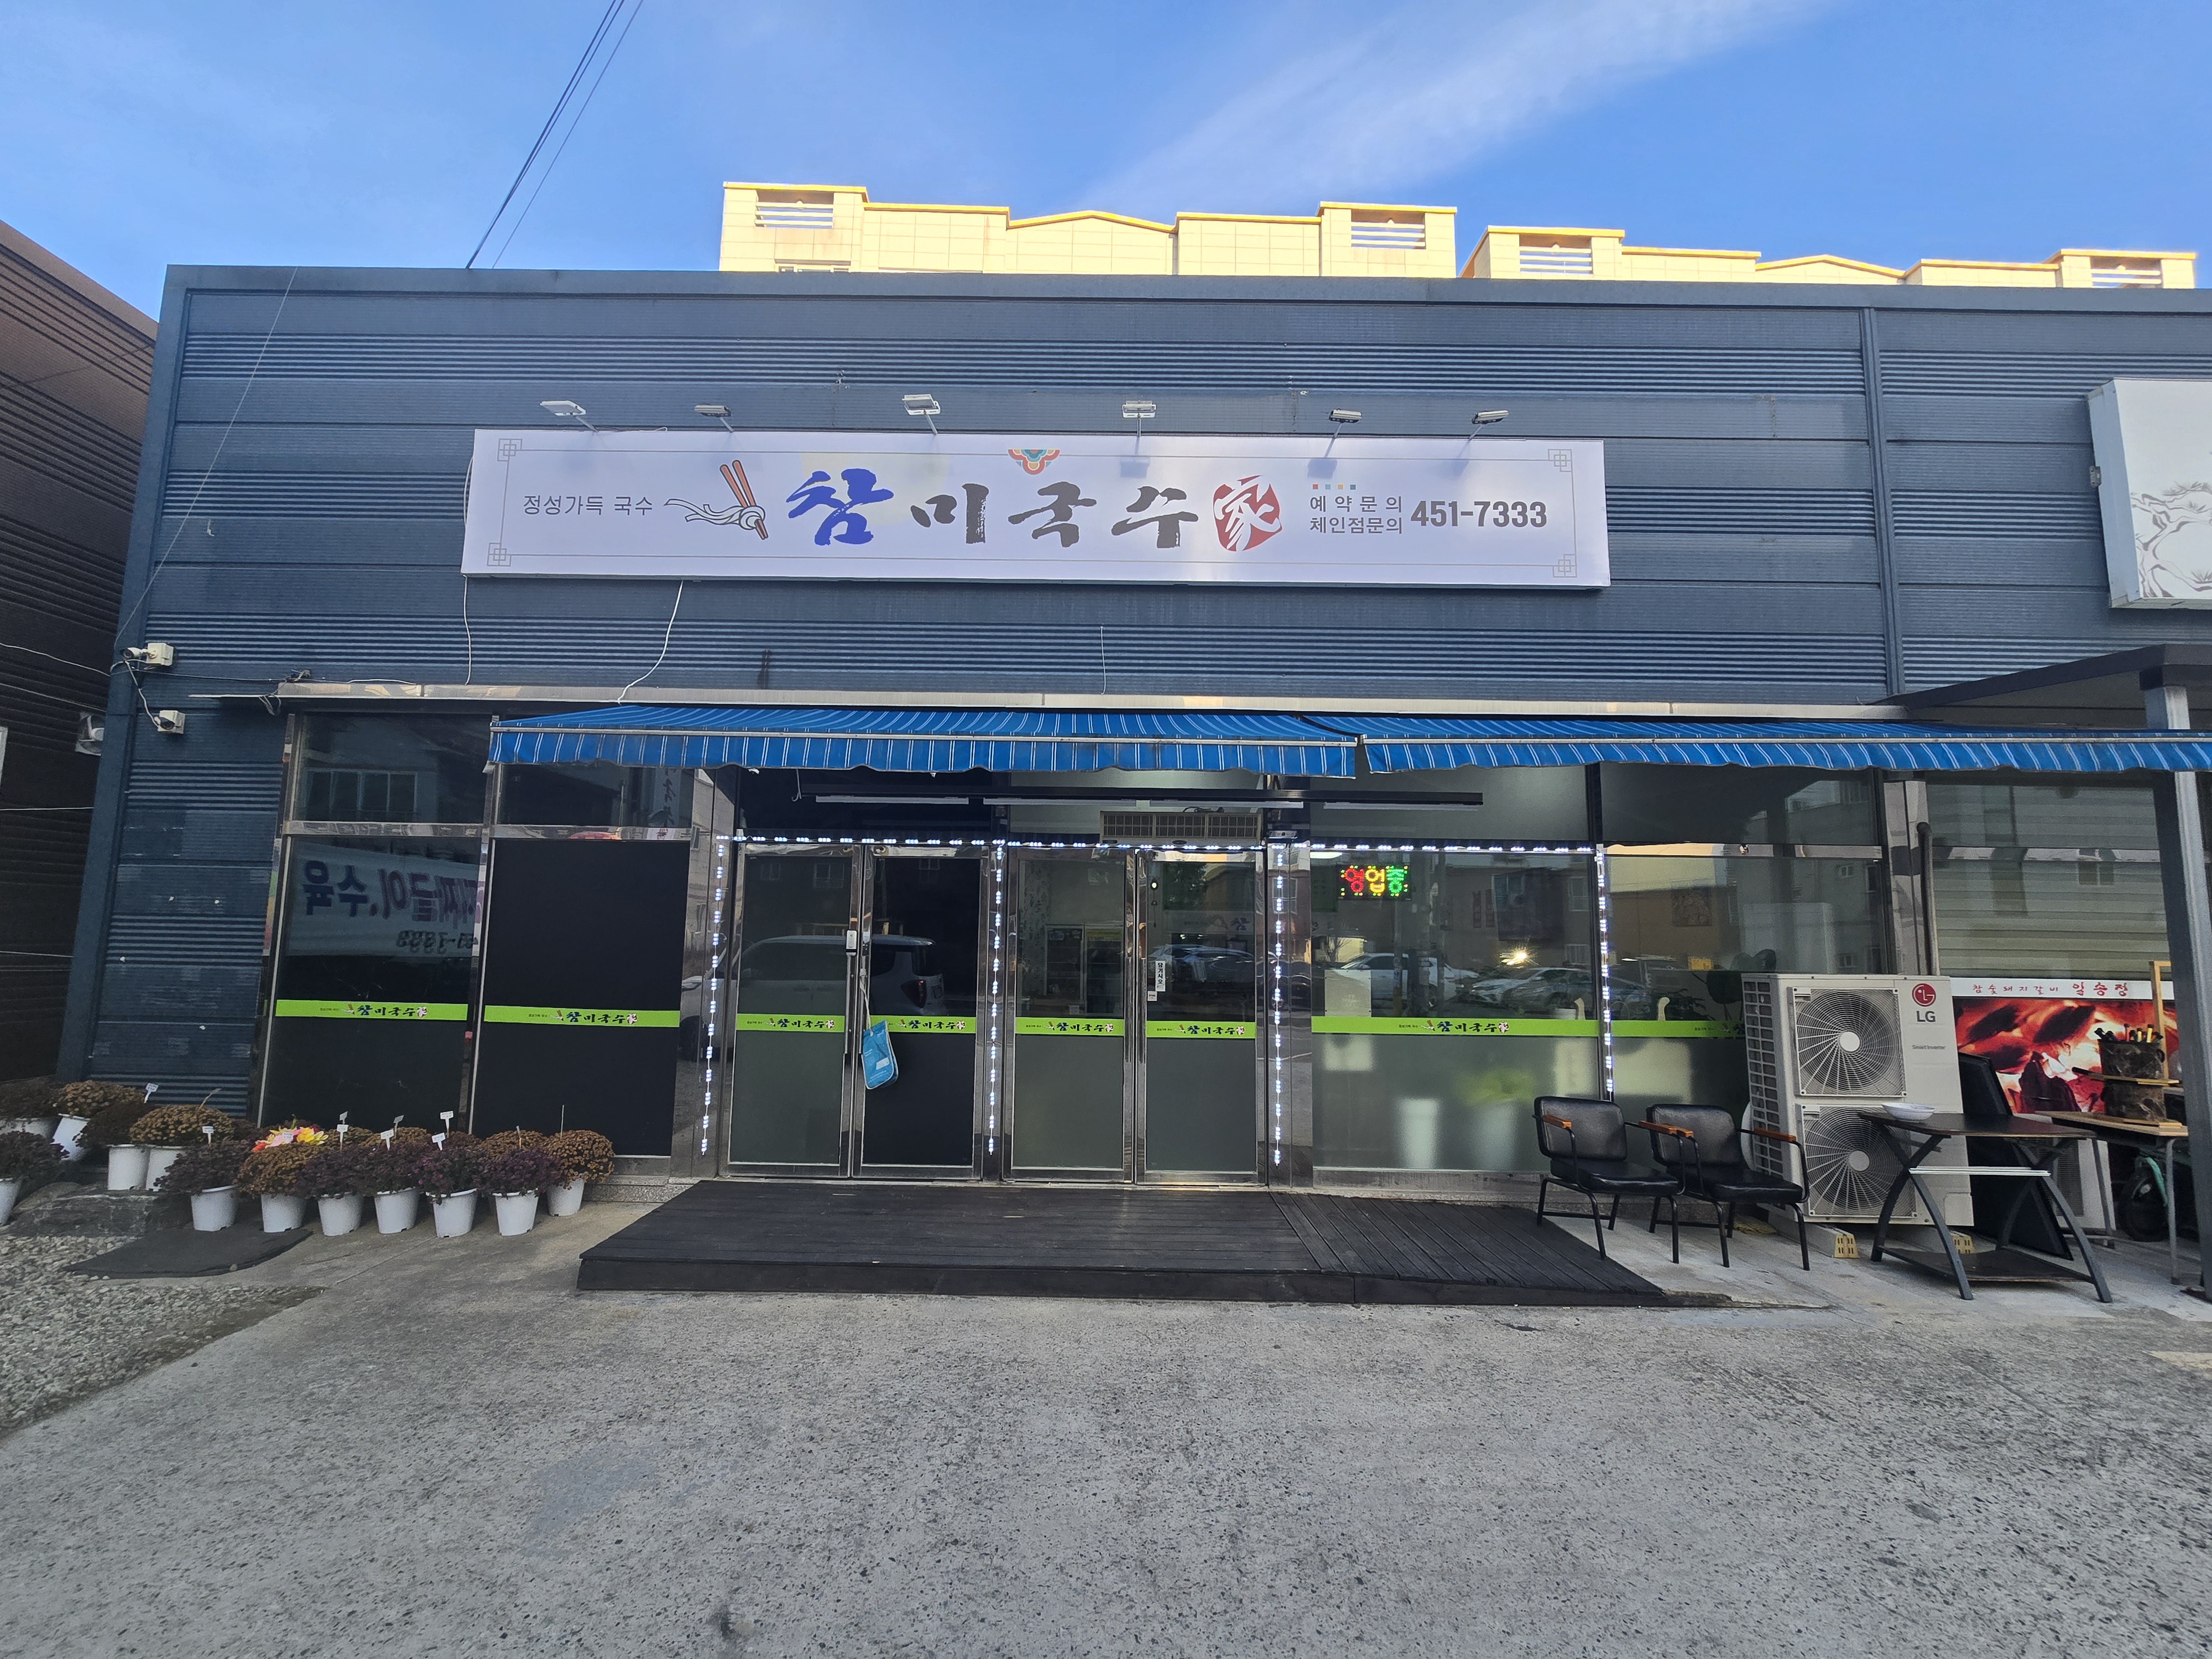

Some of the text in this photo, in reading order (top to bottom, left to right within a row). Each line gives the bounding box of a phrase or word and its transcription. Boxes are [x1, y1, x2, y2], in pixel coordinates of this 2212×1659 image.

[523, 494, 653, 516] 정성가득 국수
[1410, 500, 1547, 528] 451-7333
[1310, 517, 1402, 534] 체인점문의
[1344, 868, 1405, 893] 영업중
[1916, 1011, 1936, 1022] LG
